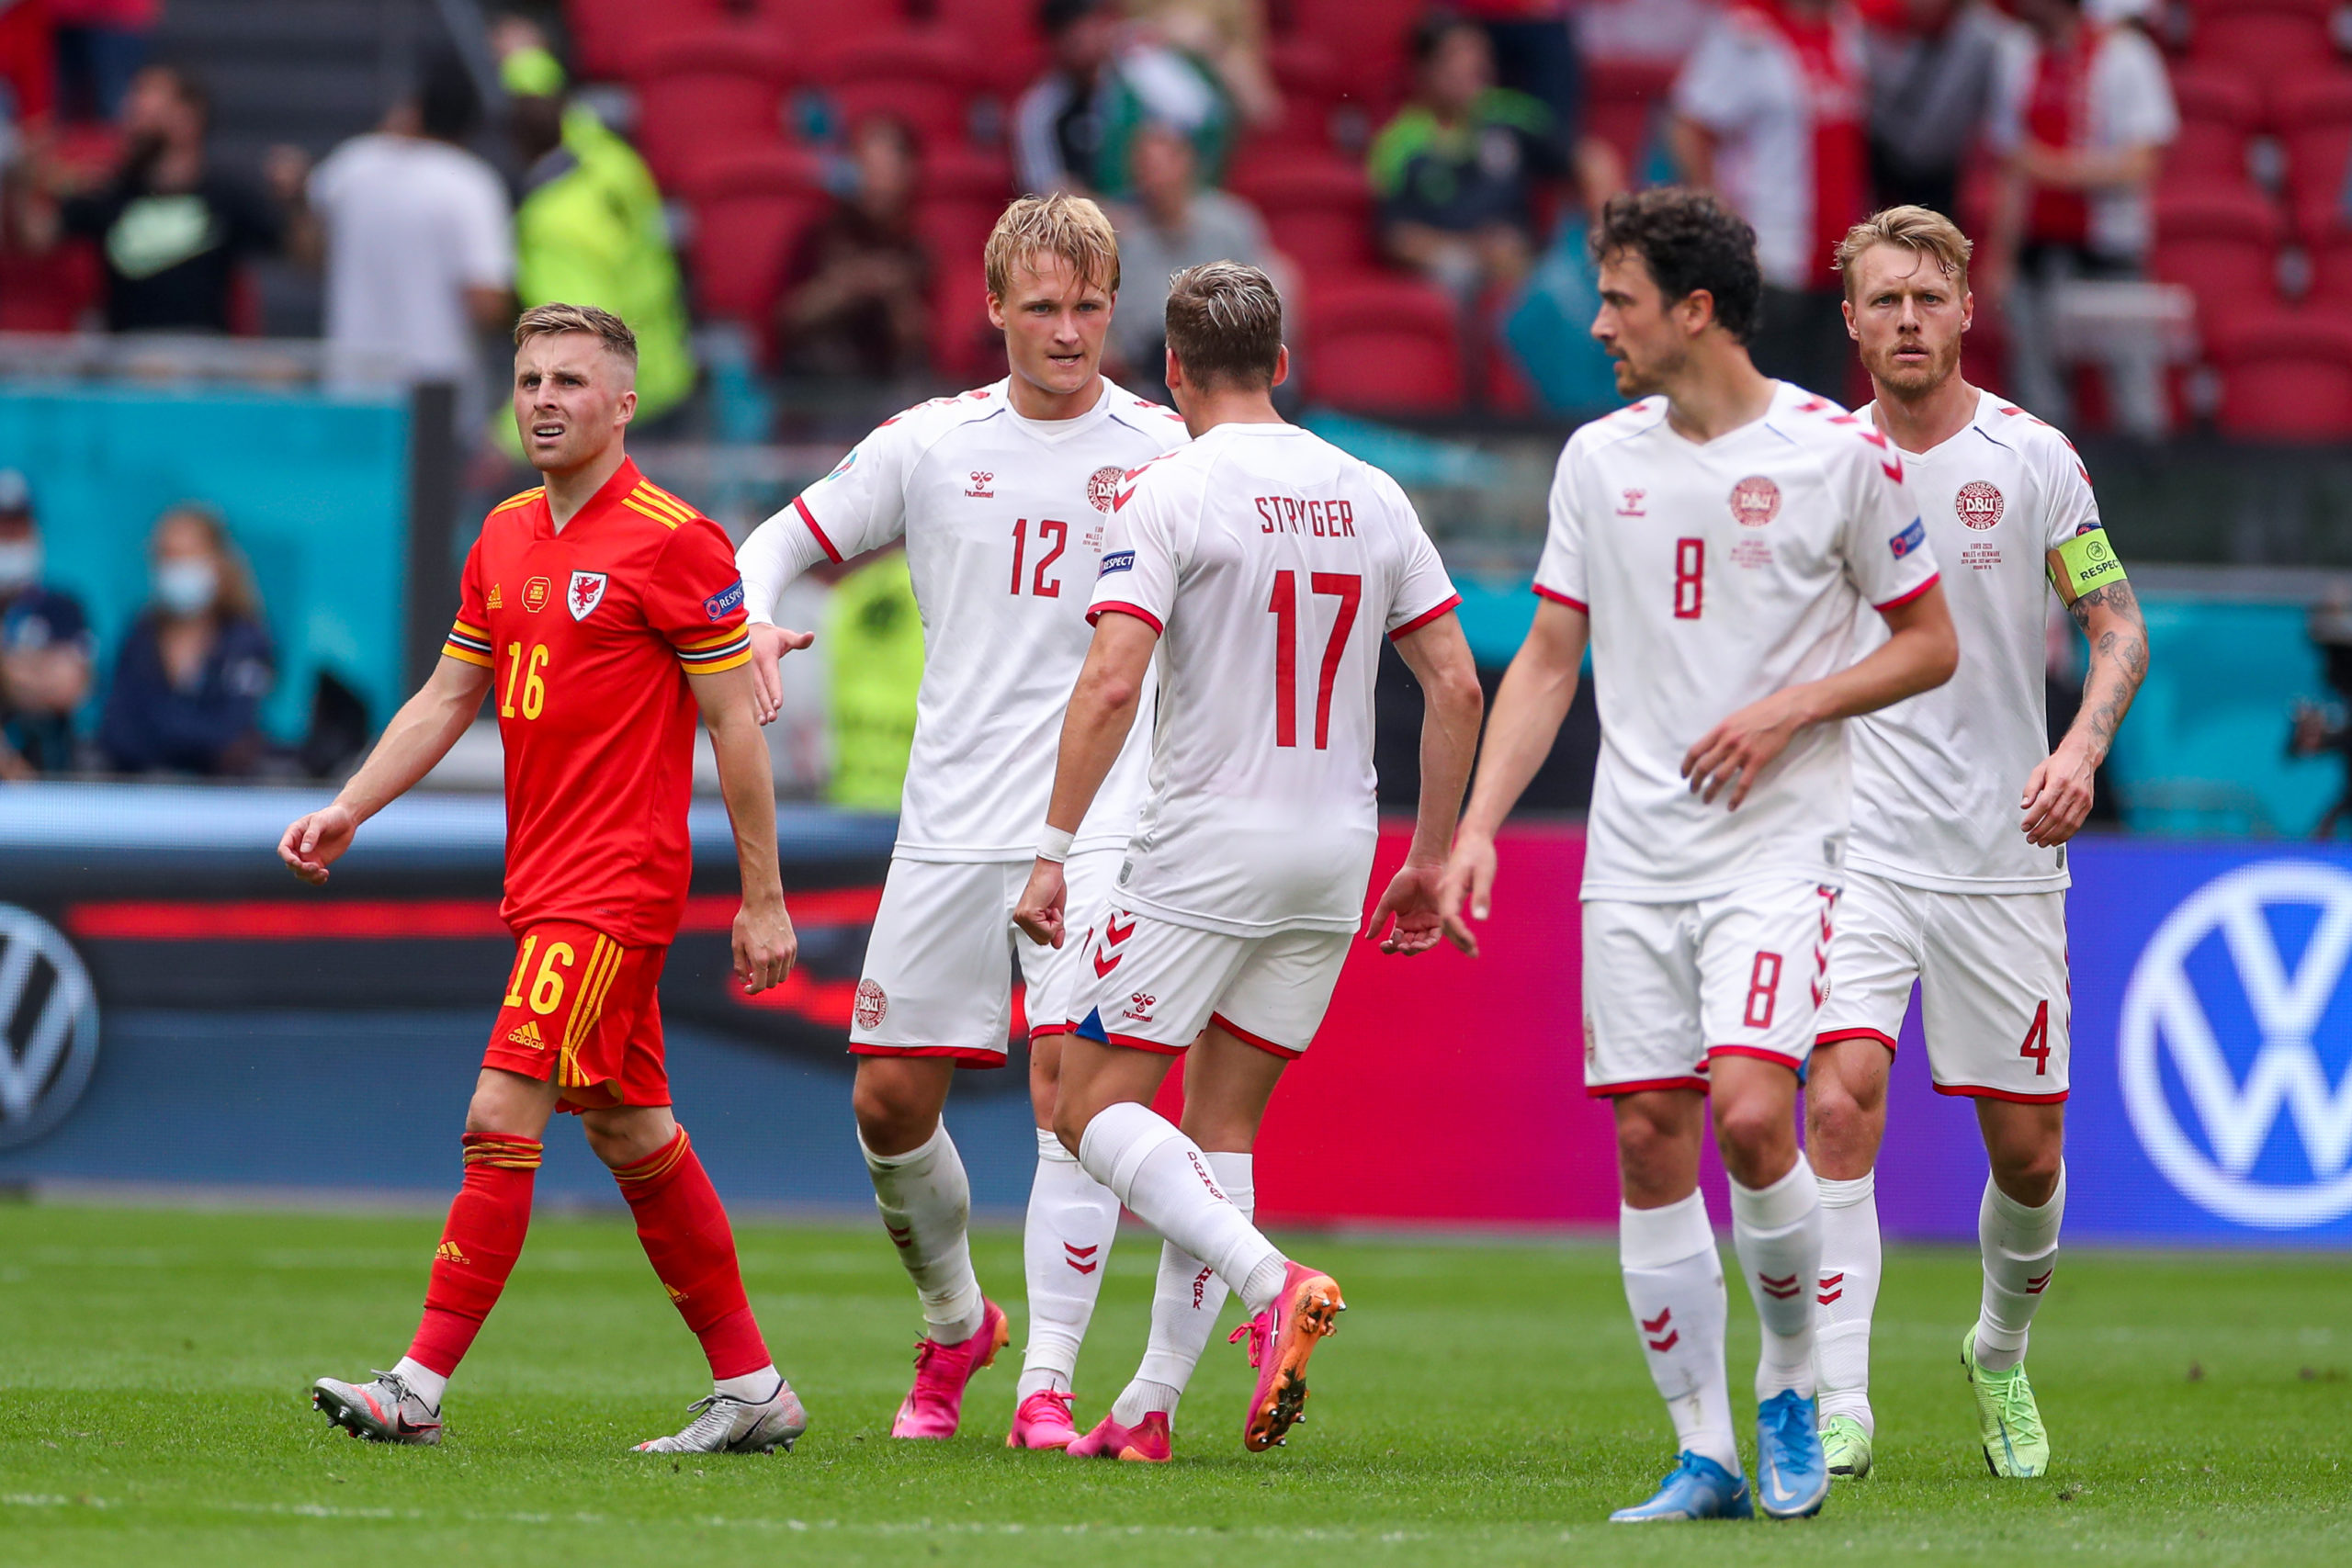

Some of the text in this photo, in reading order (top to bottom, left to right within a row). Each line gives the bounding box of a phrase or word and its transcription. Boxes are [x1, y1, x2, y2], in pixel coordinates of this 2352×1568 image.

[964, 489, 994, 498] hummel
[1097, 482, 1116, 497] DB
[1966, 497, 1994, 513] DBU
[1254, 496, 1356, 537] STRYGER
[1011, 518, 1068, 598] 12
[1674, 537, 1704, 619] 8
[719, 583, 742, 608] RESPEC
[1268, 570, 1362, 750] 17
[502, 641, 549, 721] 16
[503, 935, 575, 1015] 16
[1744, 951, 1782, 1029] 8
[860, 996, 878, 1011] DBU
[1123, 1010, 1153, 1022] hummel
[508, 1033, 545, 1050] adidas
[2019, 999, 2051, 1076] 4
